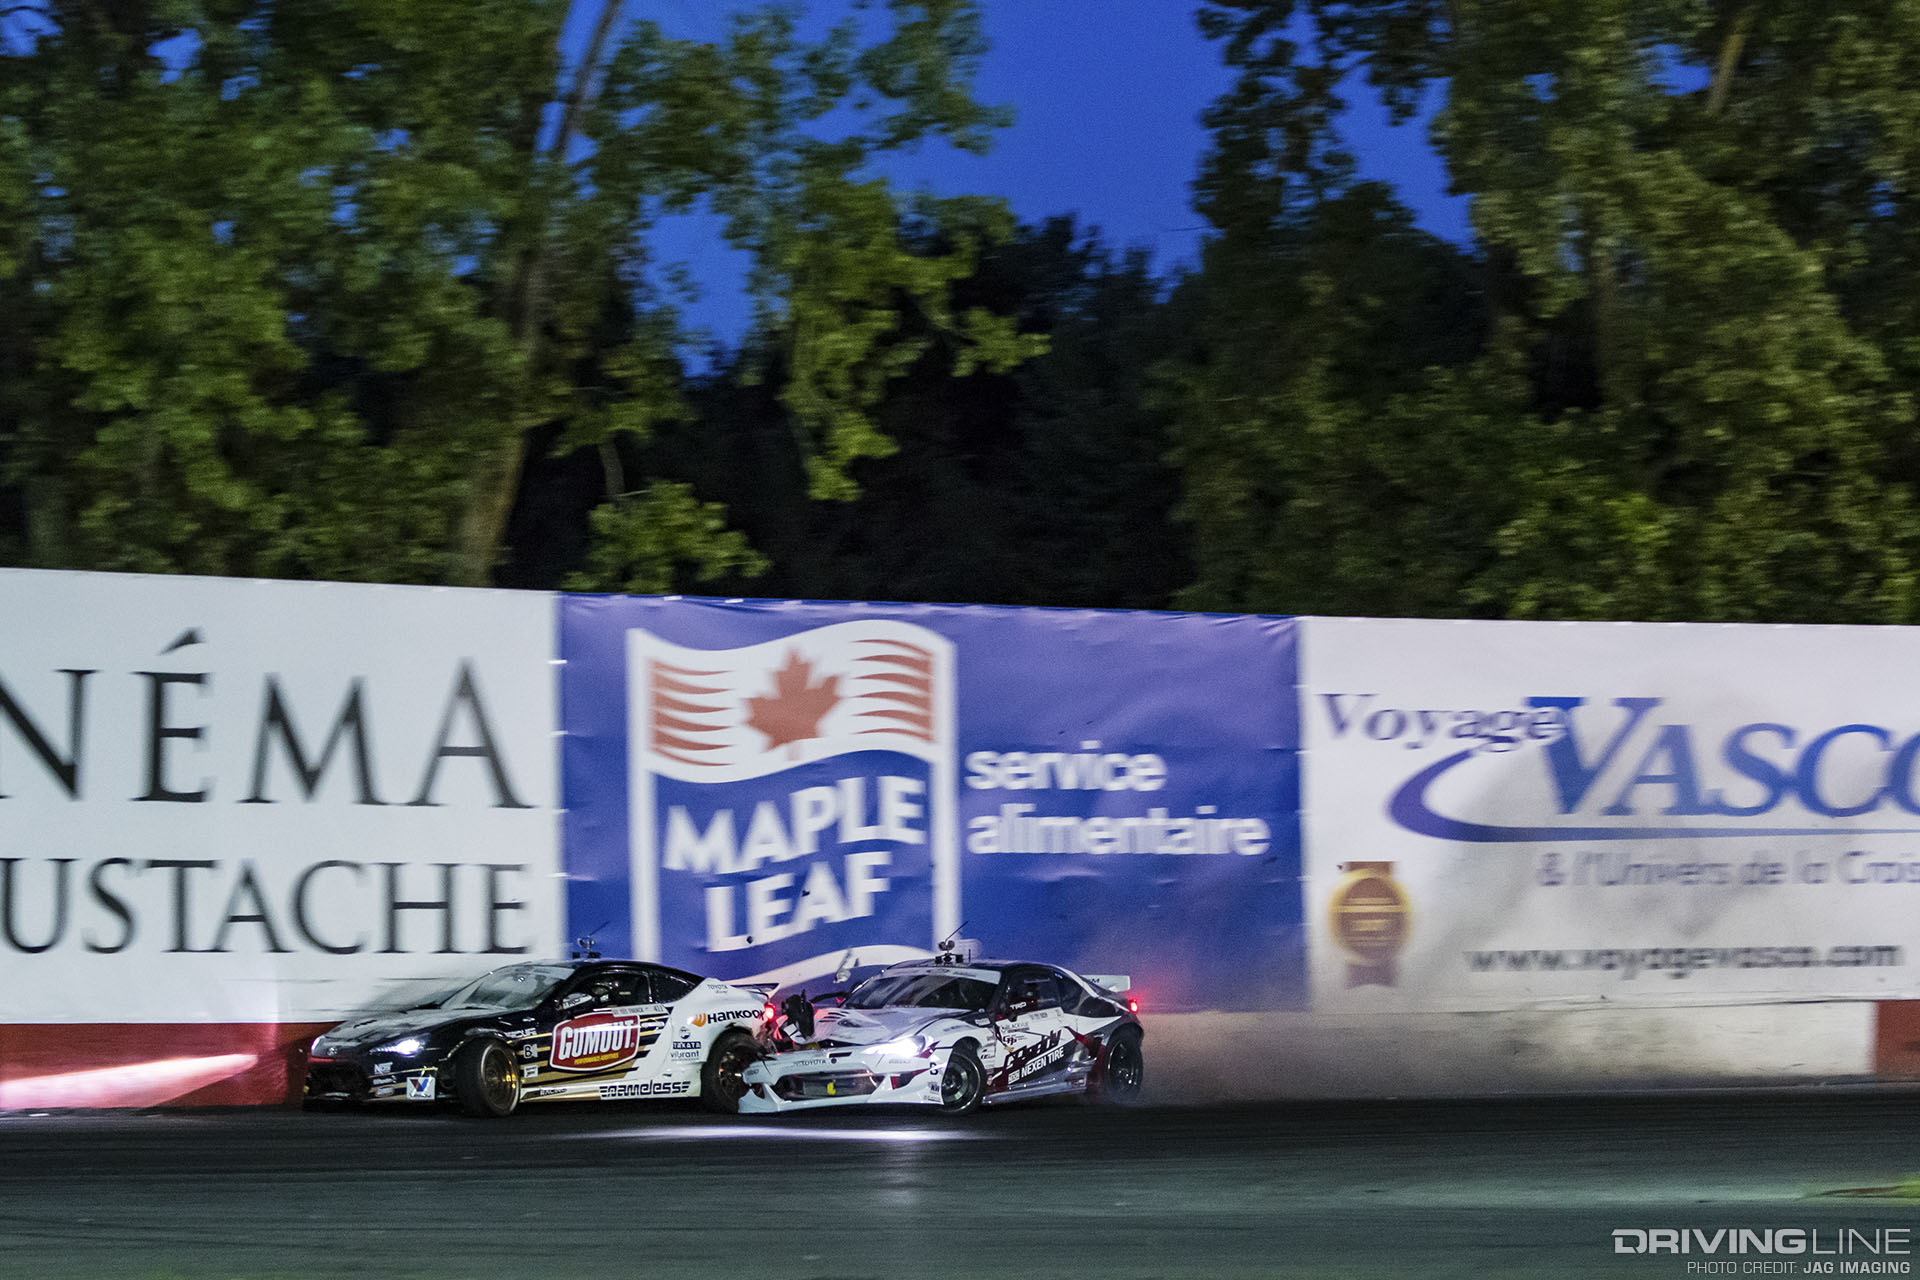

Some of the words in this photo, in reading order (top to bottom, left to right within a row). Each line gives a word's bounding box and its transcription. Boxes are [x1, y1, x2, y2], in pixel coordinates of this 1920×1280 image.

[1315, 693, 1562, 752] Voyage
[966, 739, 1167, 793] service
[663, 776, 926, 874] MAPLE
[966, 804, 1270, 856] alimentaire
[1740, 850, 1787, 886] de
[0, 858, 530, 954] USTACHE
[703, 852, 892, 951] LEAF
[1010, 1002, 1027, 1010] TRD
[558, 1020, 634, 1060] GUMOUT
[671, 1050, 700, 1059] vibrant
[1021, 1057, 1047, 1078] NEXEN
[1048, 1046, 1064, 1064] TIRE
